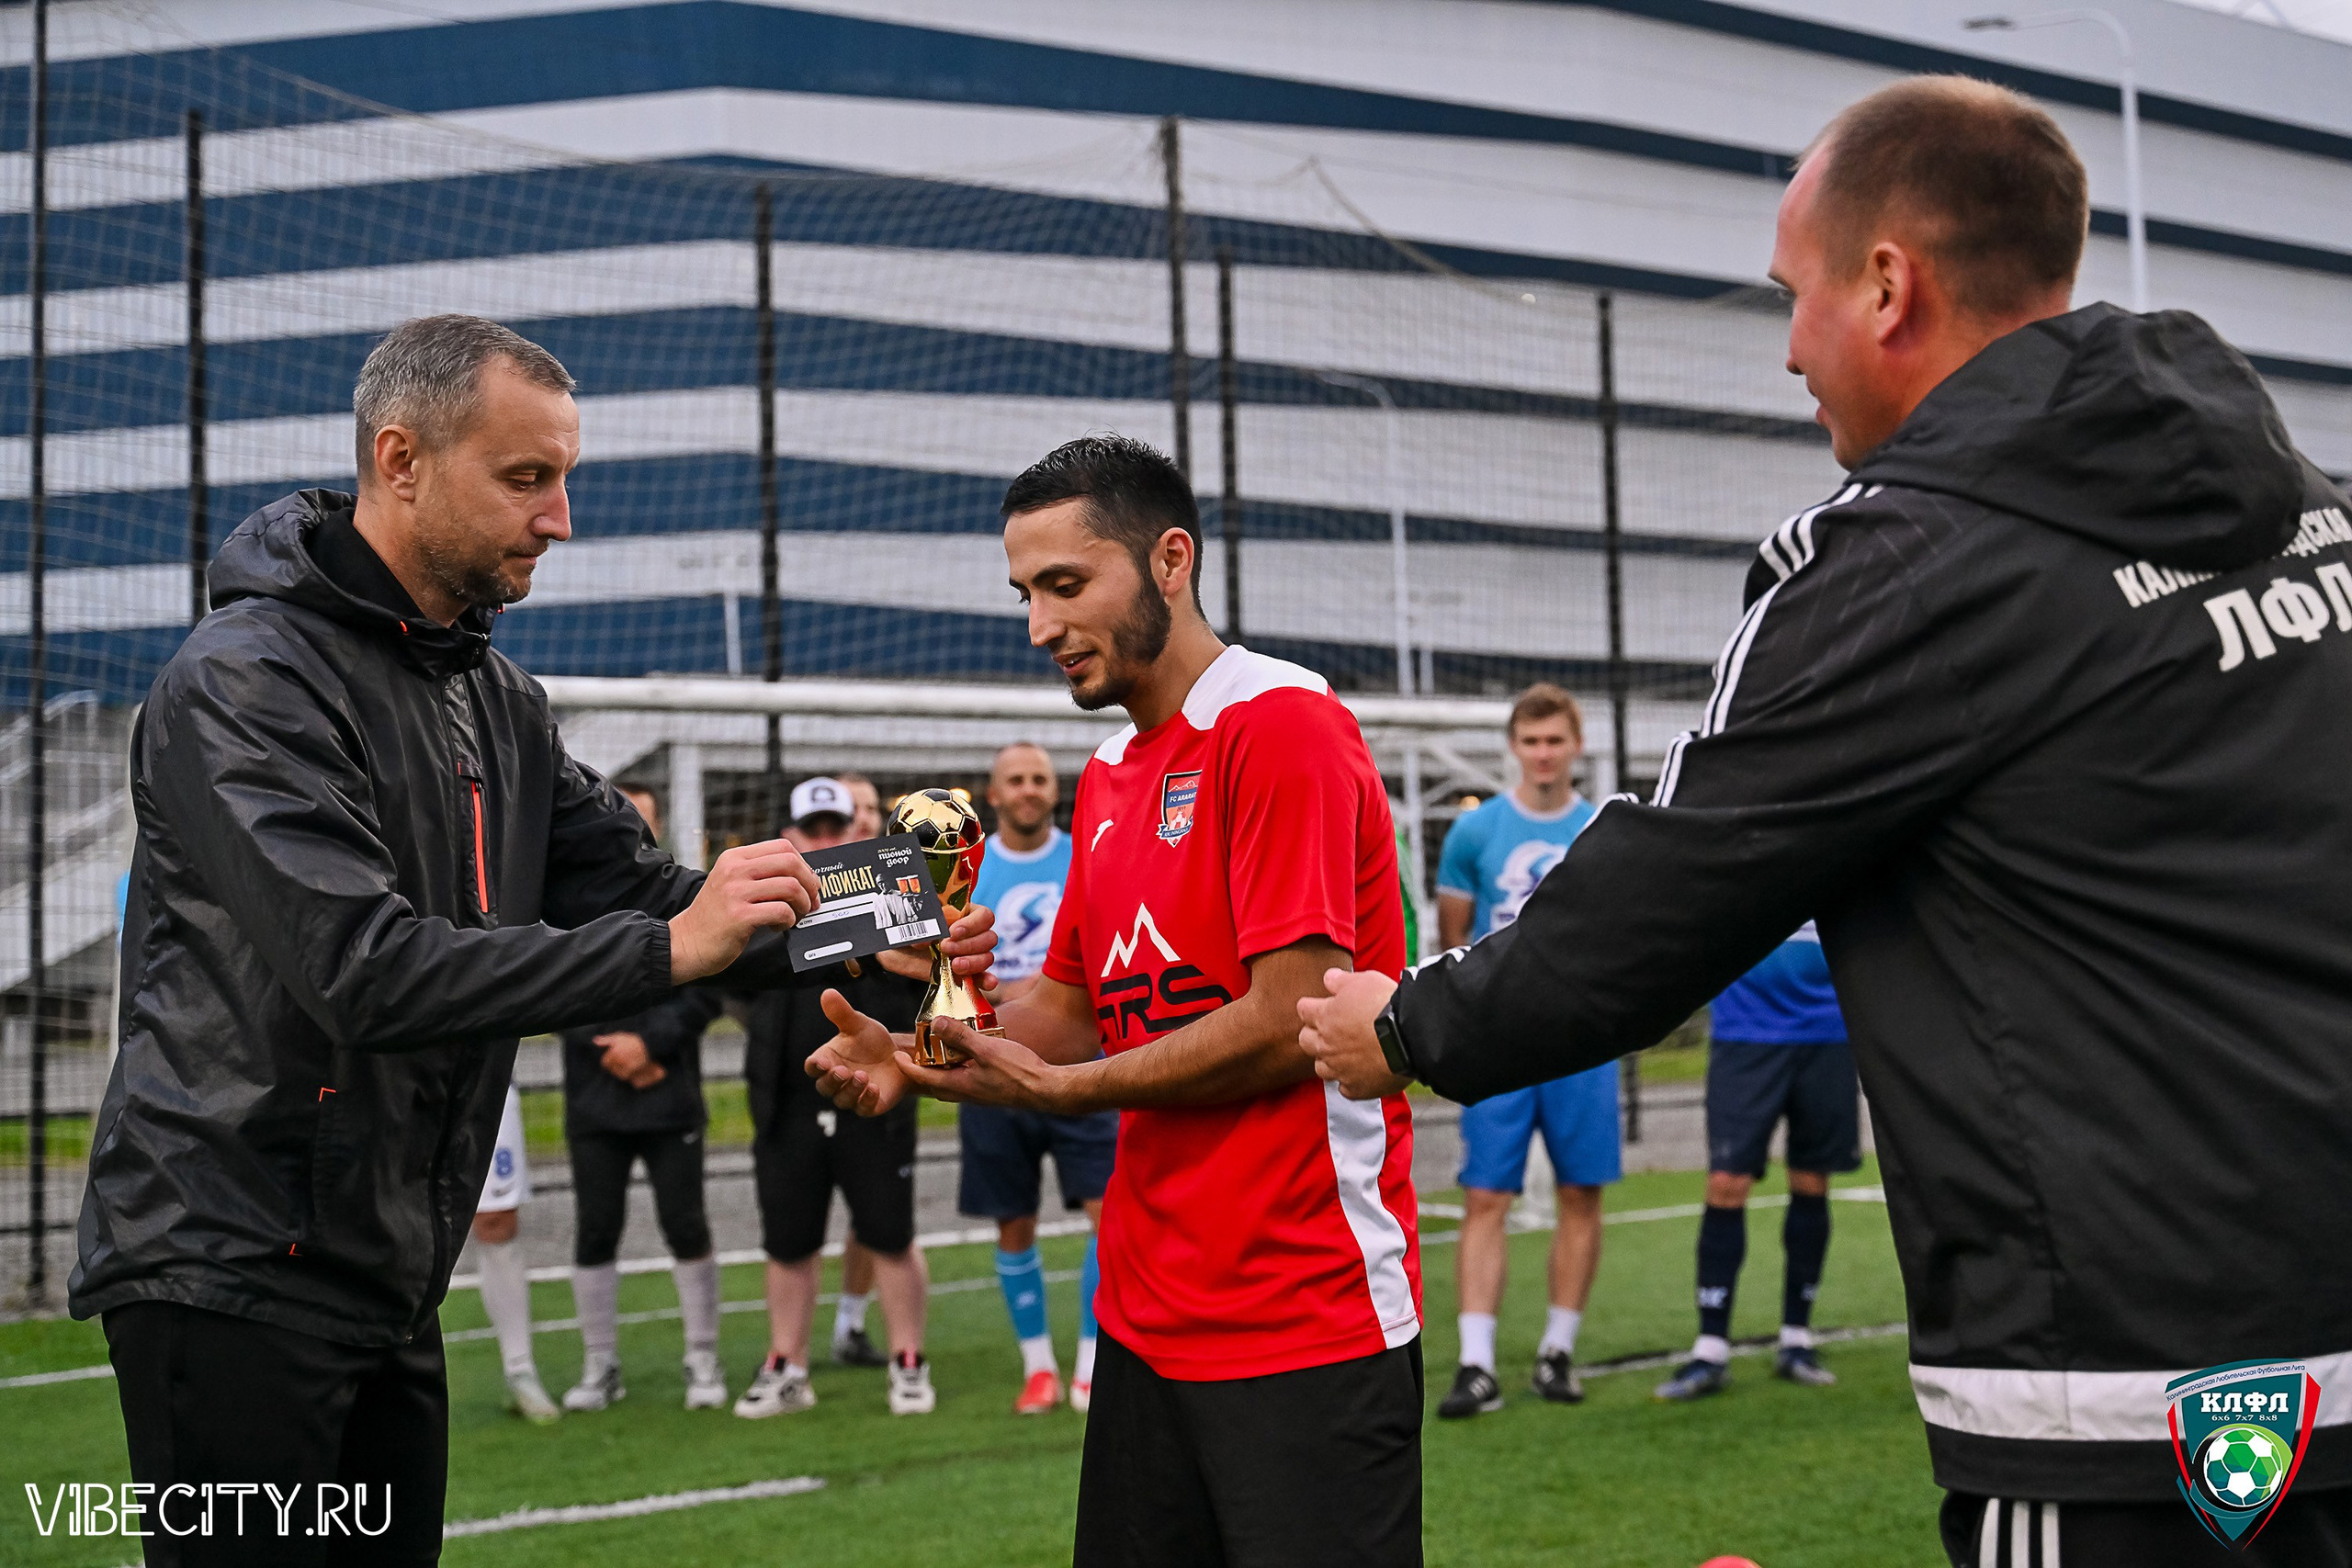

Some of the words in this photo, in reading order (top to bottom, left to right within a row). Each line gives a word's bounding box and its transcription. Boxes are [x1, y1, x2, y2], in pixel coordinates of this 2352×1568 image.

[2202, 561, 2352, 673] ЛФЛ
[819, 865, 876, 899] ИФИКАТ
[495, 1147, 514, 1179] 8
